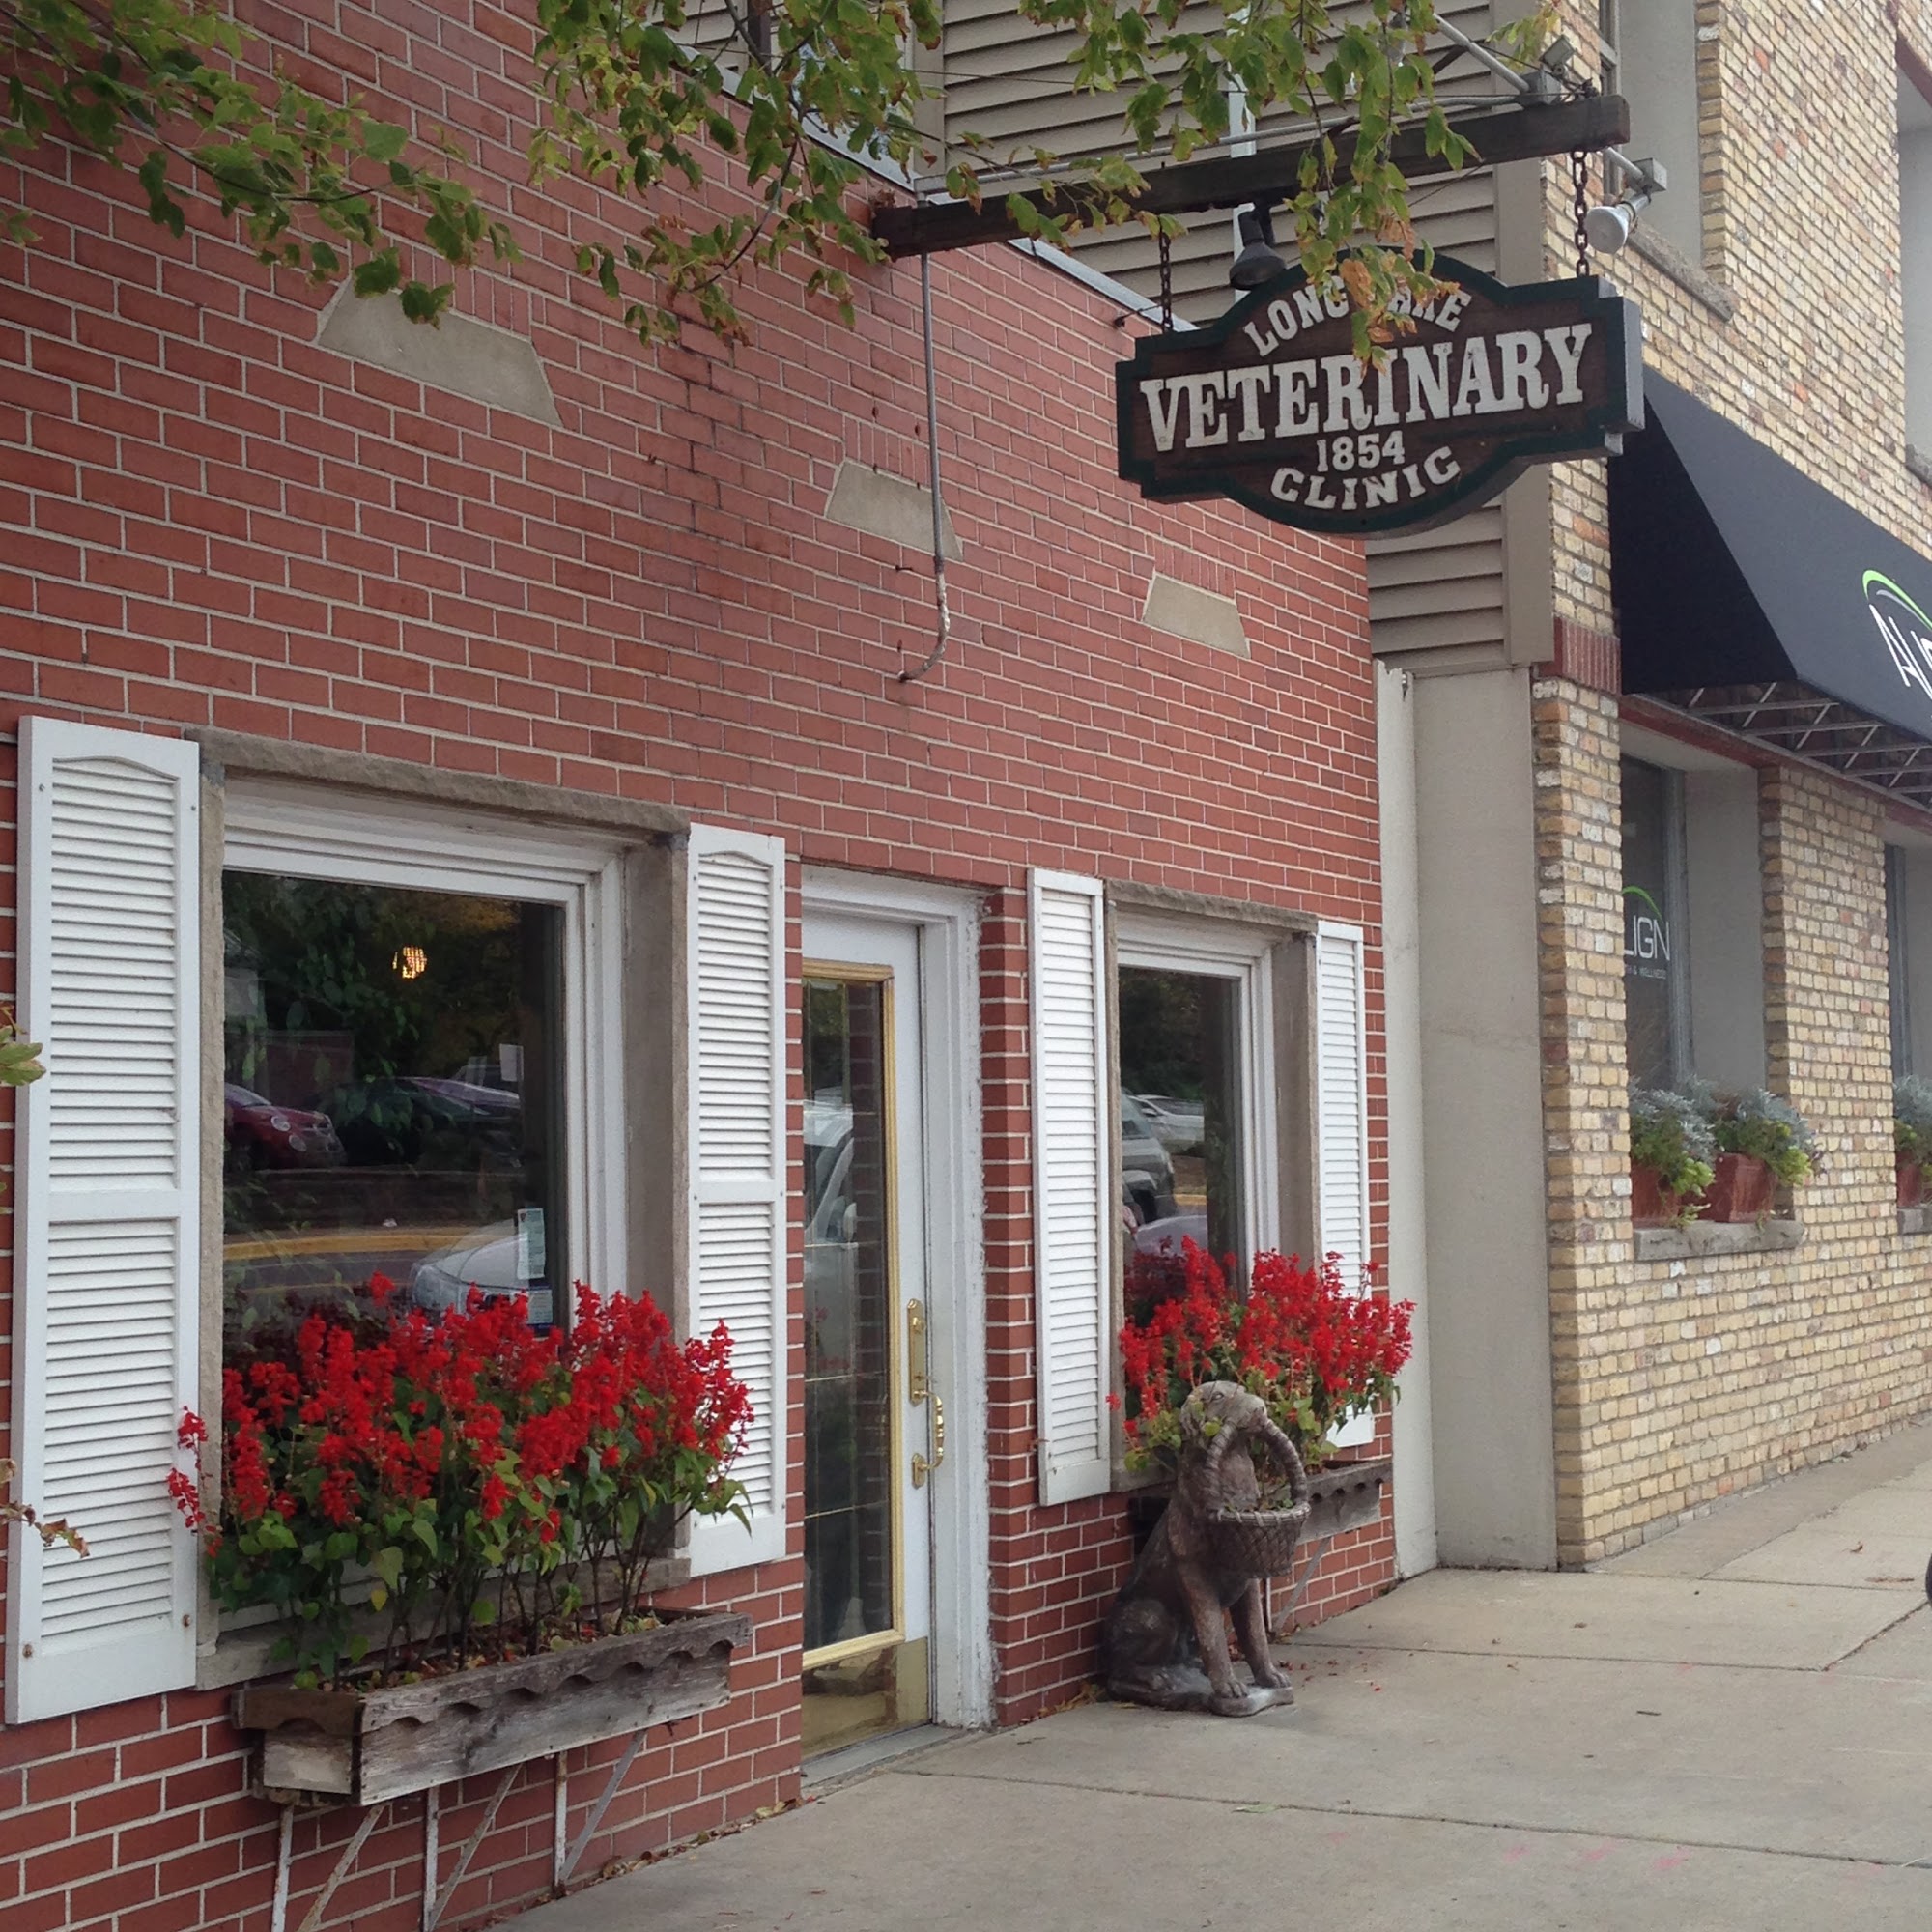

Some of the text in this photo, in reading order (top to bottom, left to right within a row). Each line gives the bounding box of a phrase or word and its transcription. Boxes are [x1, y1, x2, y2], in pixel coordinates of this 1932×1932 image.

[1243, 275, 1350, 356] LONG
[1140, 324, 1592, 451] VETERINARY
[1270, 446, 1461, 510] CLINIC
[1317, 431, 1405, 472] 1854
